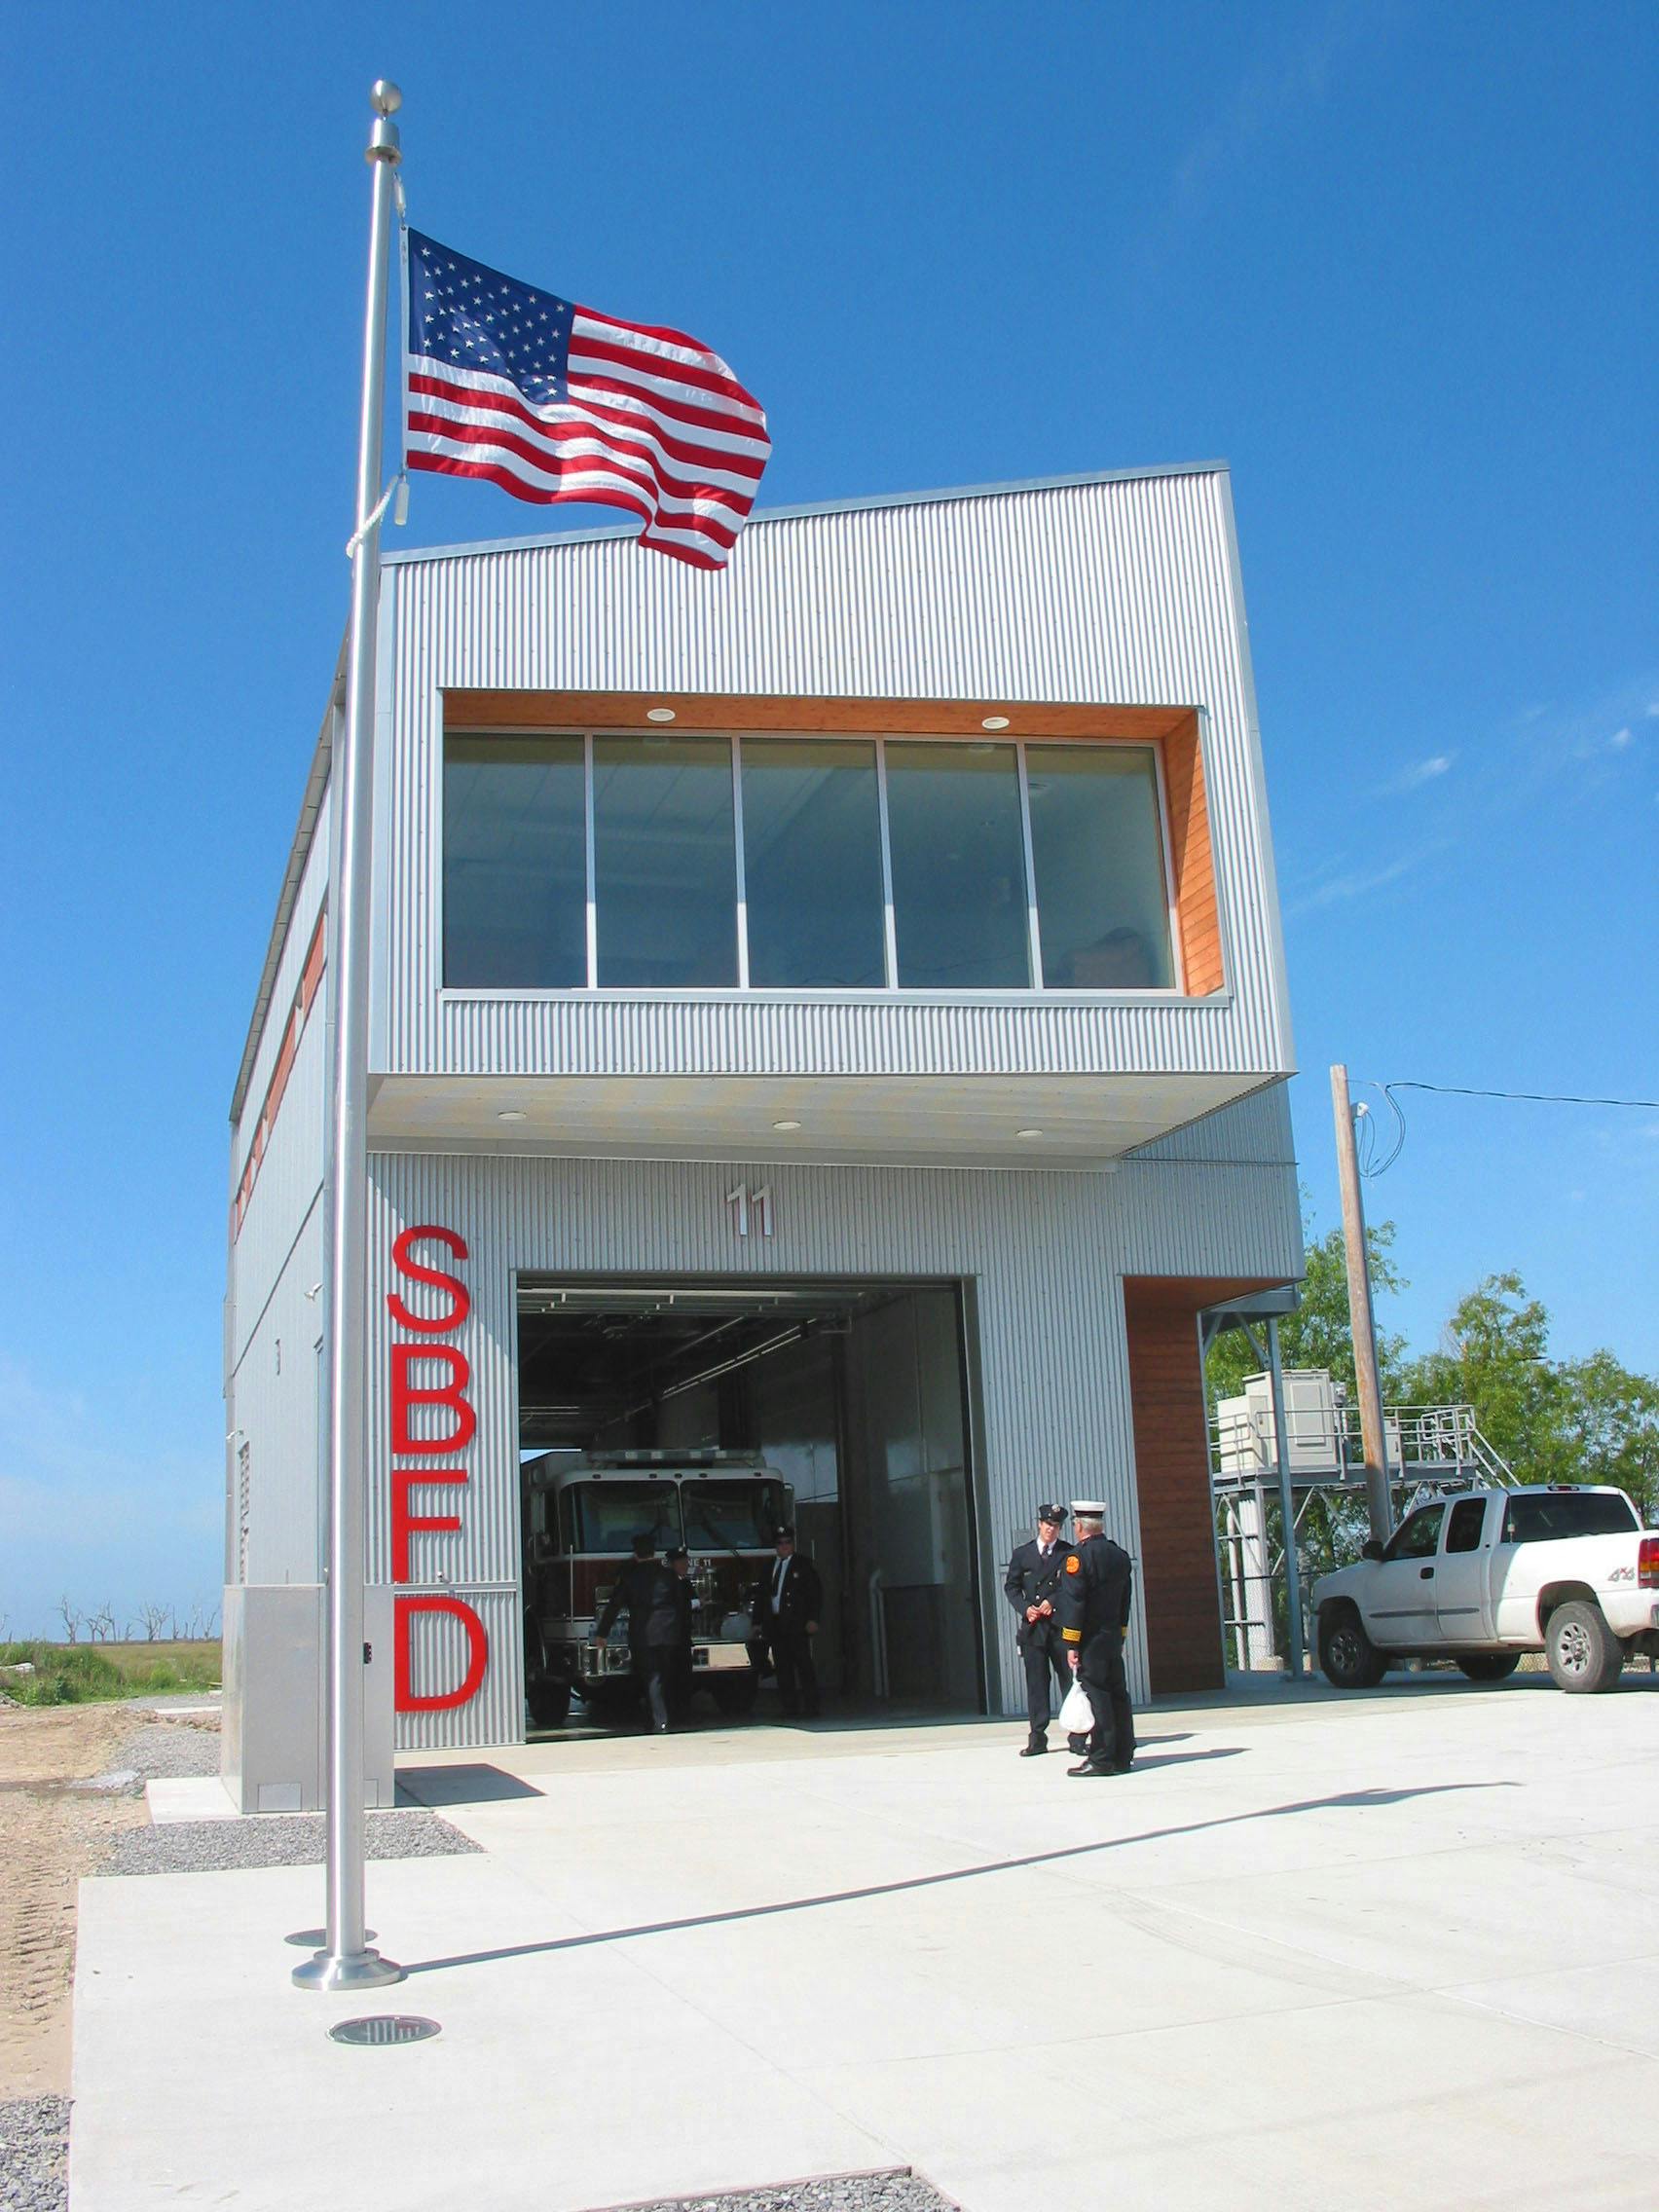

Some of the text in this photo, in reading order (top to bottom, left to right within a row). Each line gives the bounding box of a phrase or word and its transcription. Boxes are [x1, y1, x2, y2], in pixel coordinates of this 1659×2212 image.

[726, 1184, 772, 1236] 11
[387, 1224, 488, 1713] SBFD
[703, 1558, 711, 1567] 11
